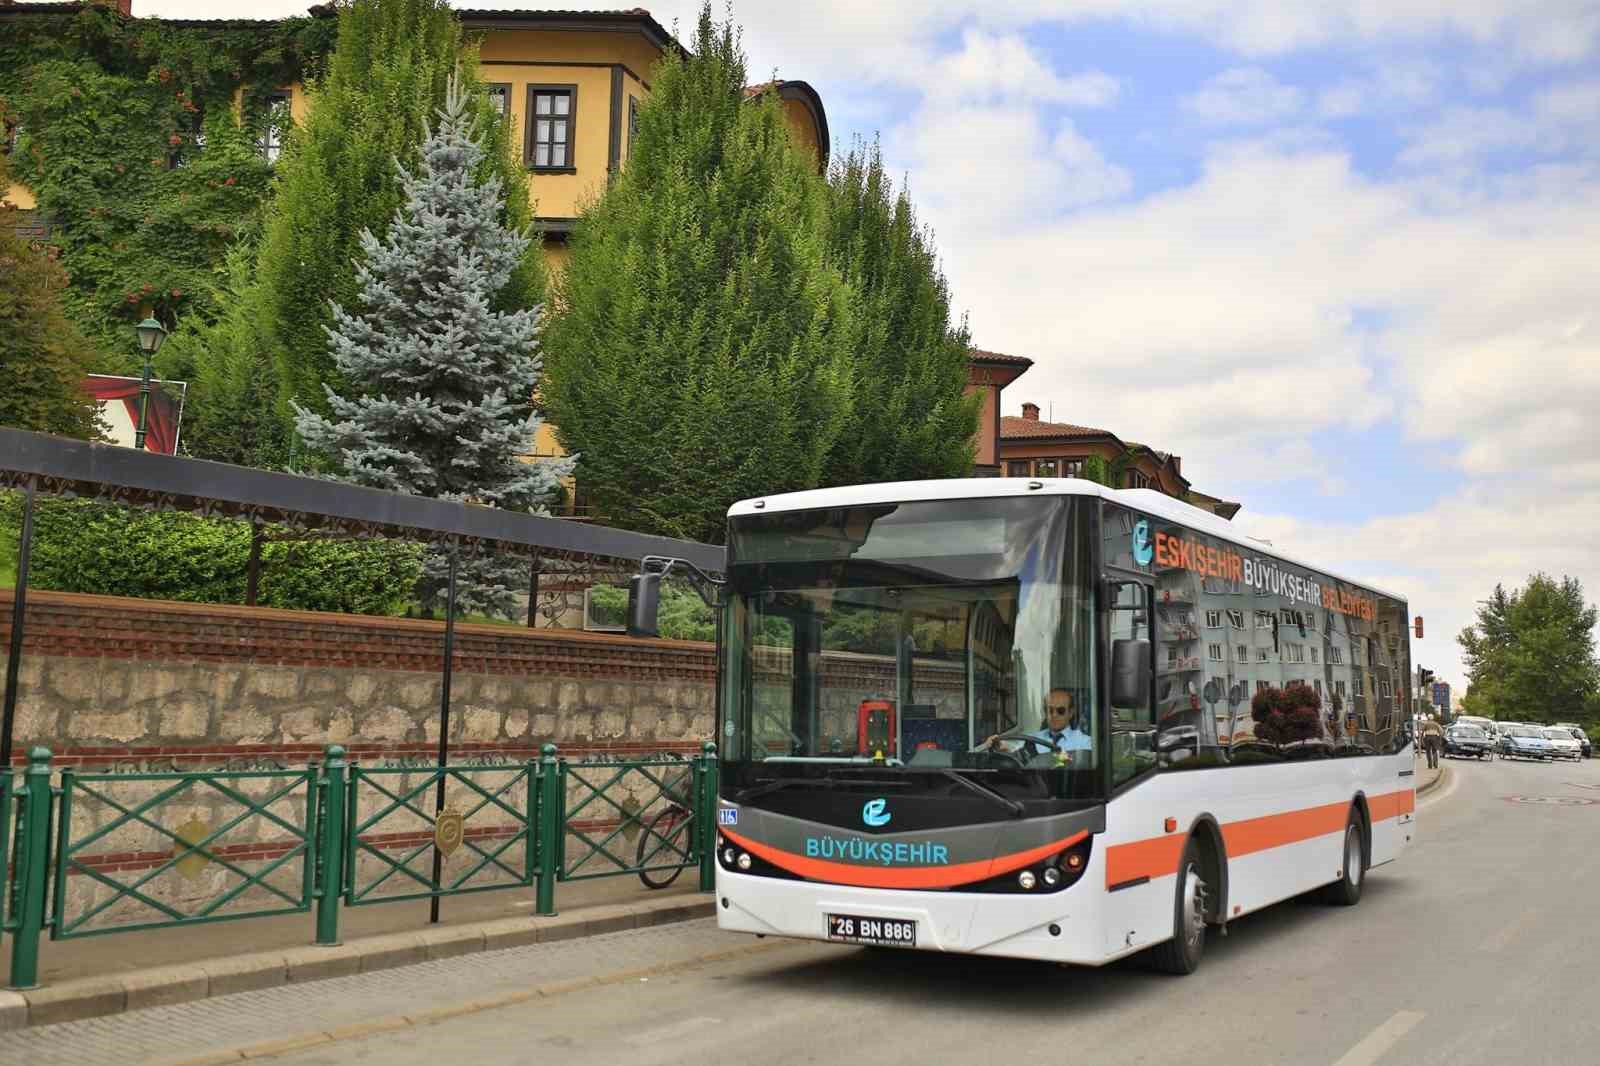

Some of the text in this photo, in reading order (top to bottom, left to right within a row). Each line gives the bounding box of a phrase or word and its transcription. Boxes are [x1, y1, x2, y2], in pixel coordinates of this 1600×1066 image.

[1155, 532, 1242, 582] ESKİŞEHİR
[1244, 558, 1322, 605] BÜYÜKŞEHİR
[806, 836, 948, 865] BÜYÜKŞEHİR
[837, 918, 854, 935] 26
[860, 920, 881, 938] BN
